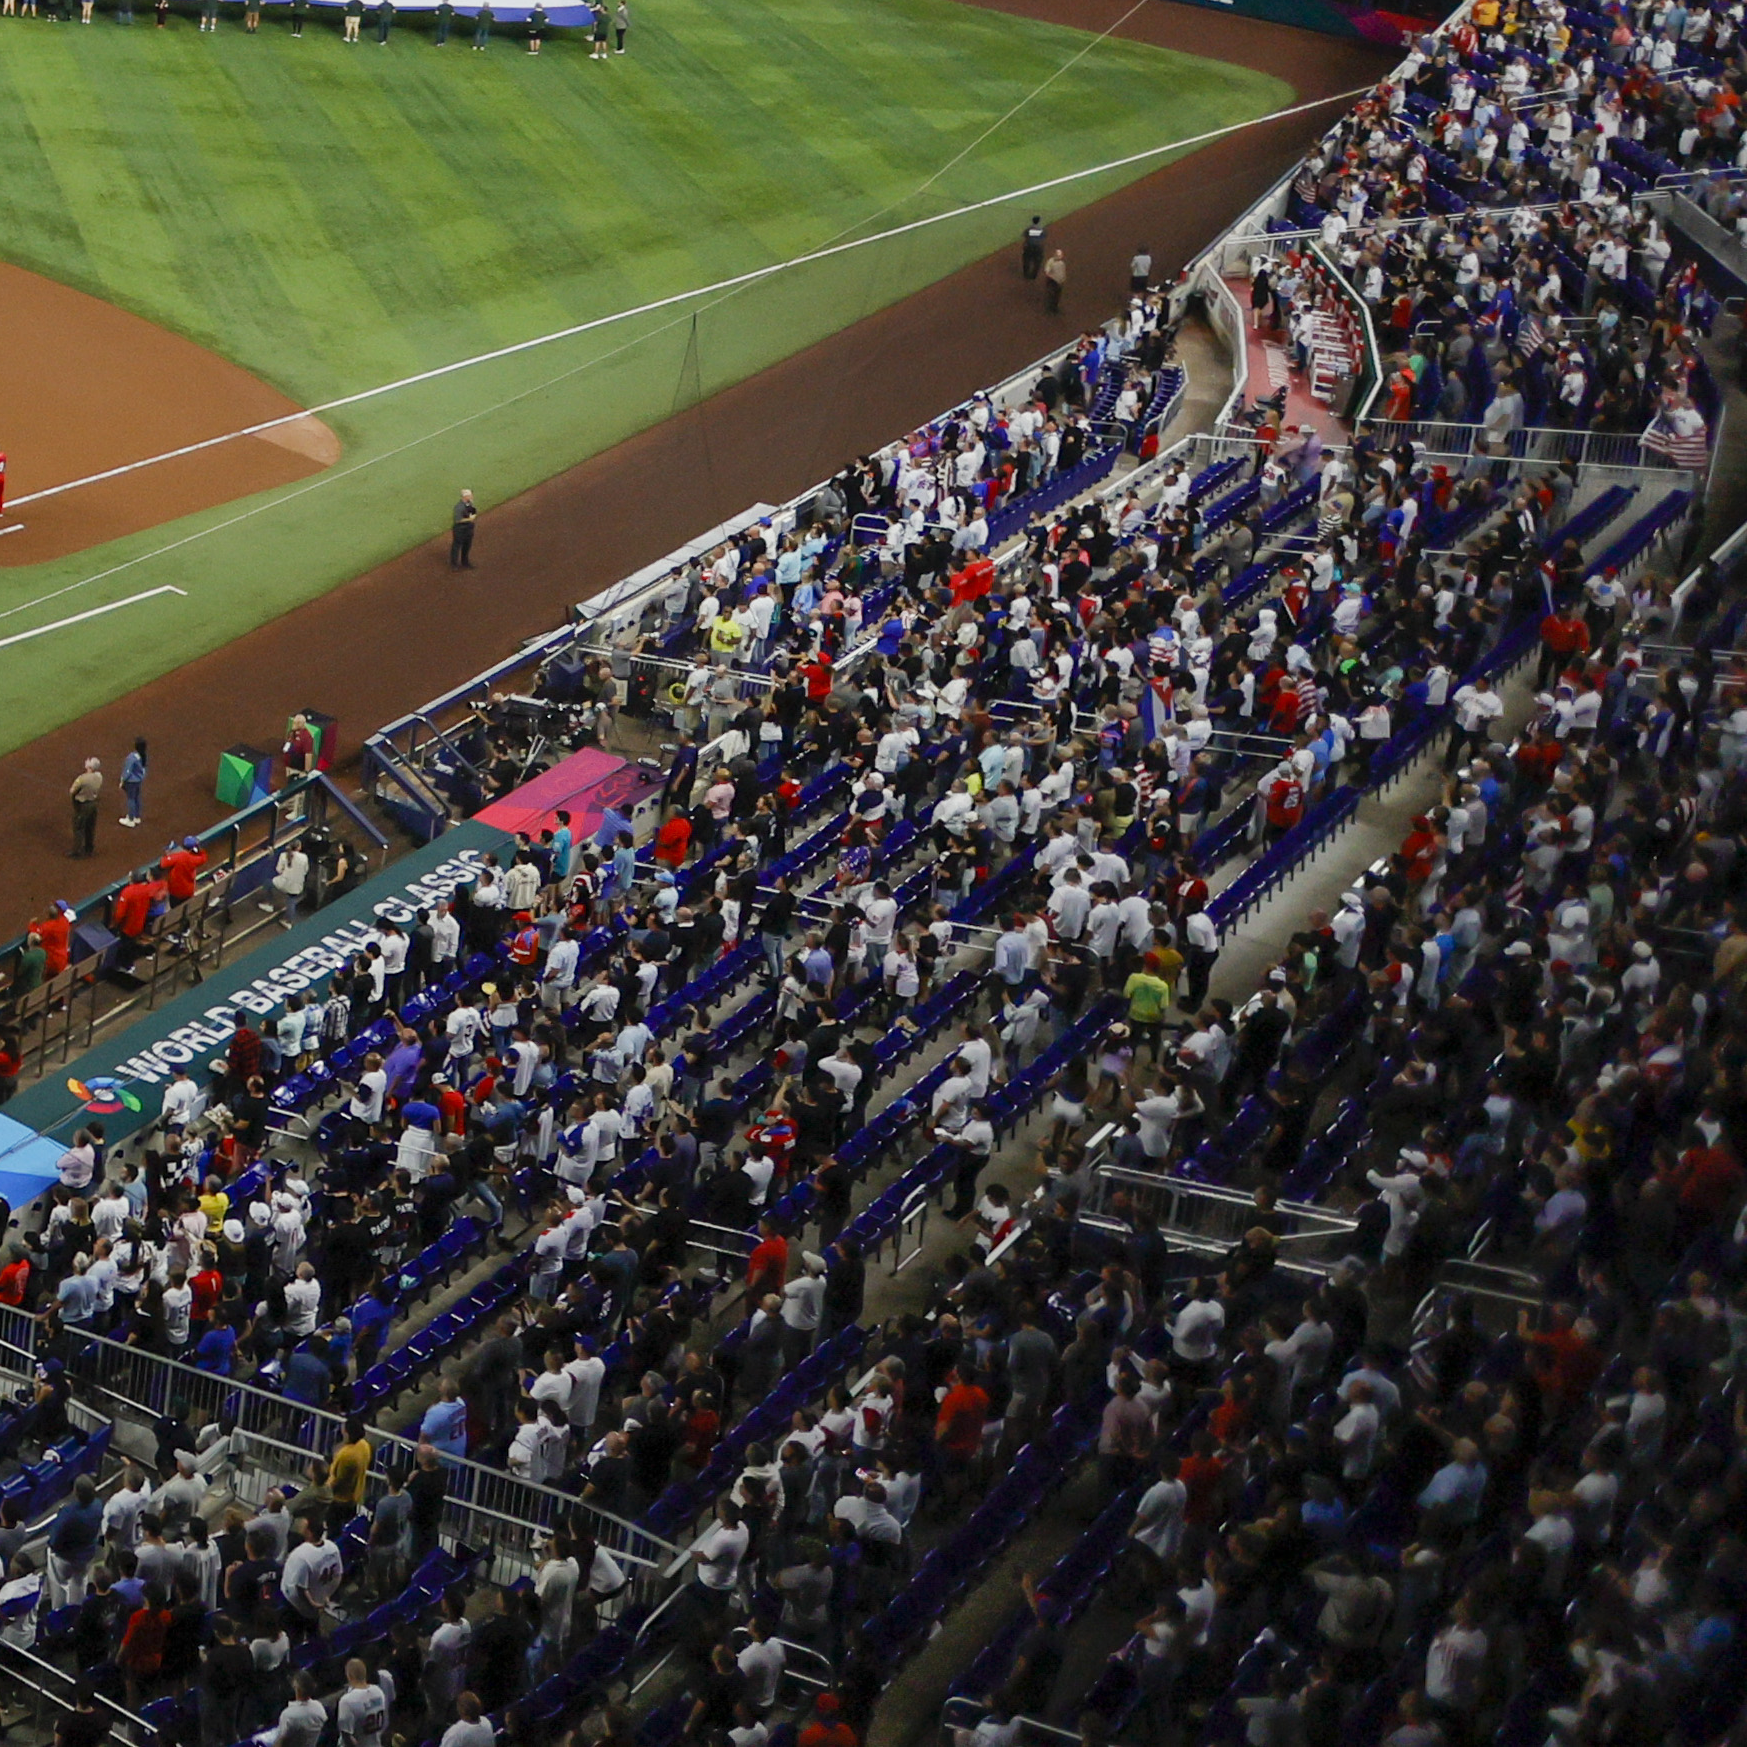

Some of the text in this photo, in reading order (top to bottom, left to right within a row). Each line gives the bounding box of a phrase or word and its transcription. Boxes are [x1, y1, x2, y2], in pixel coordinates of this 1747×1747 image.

[115, 849, 486, 1085] WORLD BASEBALL CLASSIC
